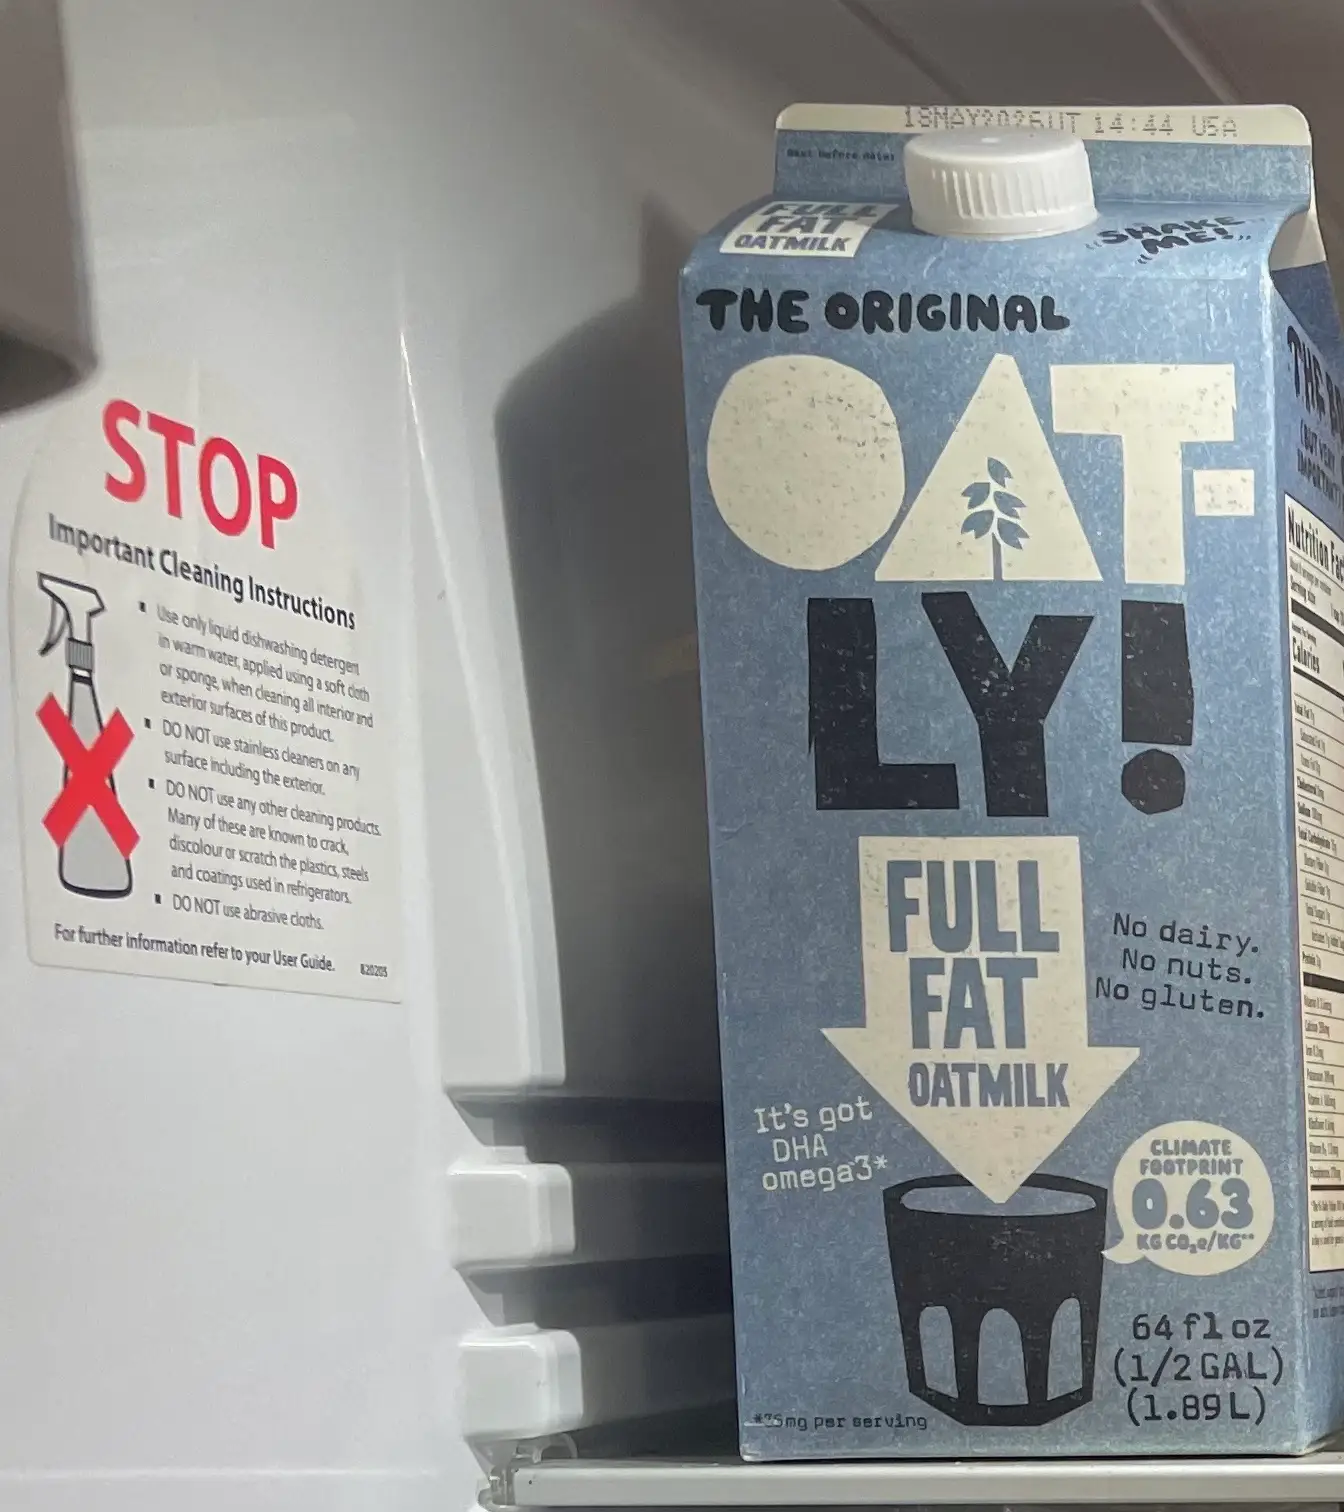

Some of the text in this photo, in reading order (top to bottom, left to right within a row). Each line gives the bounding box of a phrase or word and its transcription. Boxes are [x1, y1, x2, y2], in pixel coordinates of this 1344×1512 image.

[1095, 112, 1238, 138] 14:44 USA
[733, 234, 853, 252] OATMILK
[755, 215, 858, 234] FAT
[1096, 216, 1246, 245] SHAKE
[1140, 227, 1236, 255] ME!
[695, 288, 1071, 334] THE ORIGINAL
[102, 397, 298, 550] STOP
[1288, 504, 1329, 571] Nutrition
[48, 512, 356, 631] Important Cleaning Instructions
[806, 591, 1194, 817] LY!
[173, 893, 325, 931] DO NOT use abrasive cloths.
[886, 859, 1061, 953] FULL
[54, 921, 336, 973] For further information refer to your User Guide.
[1113, 913, 1259, 957] No dairy.
[1121, 947, 1252, 986] No nuts.
[908, 957, 1040, 1051] FAT
[1095, 976, 1265, 1019] No gluten.
[906, 1061, 1070, 1109] OATMILK
[754, 1095, 873, 1134] It's got
[772, 1133, 829, 1163] DHA
[1139, 1158, 1244, 1176] FOOTPRINT
[1150, 1138, 1232, 1156] CLIMATE
[1131, 1177, 1254, 1230] 0.63
[1132, 1312, 1271, 1341] 64 fl oz
[1114, 1346, 1283, 1387] (1/2 GAL)
[852, 1413, 928, 1431] serving
[1127, 1386, 1266, 1426] (1.89 L)
